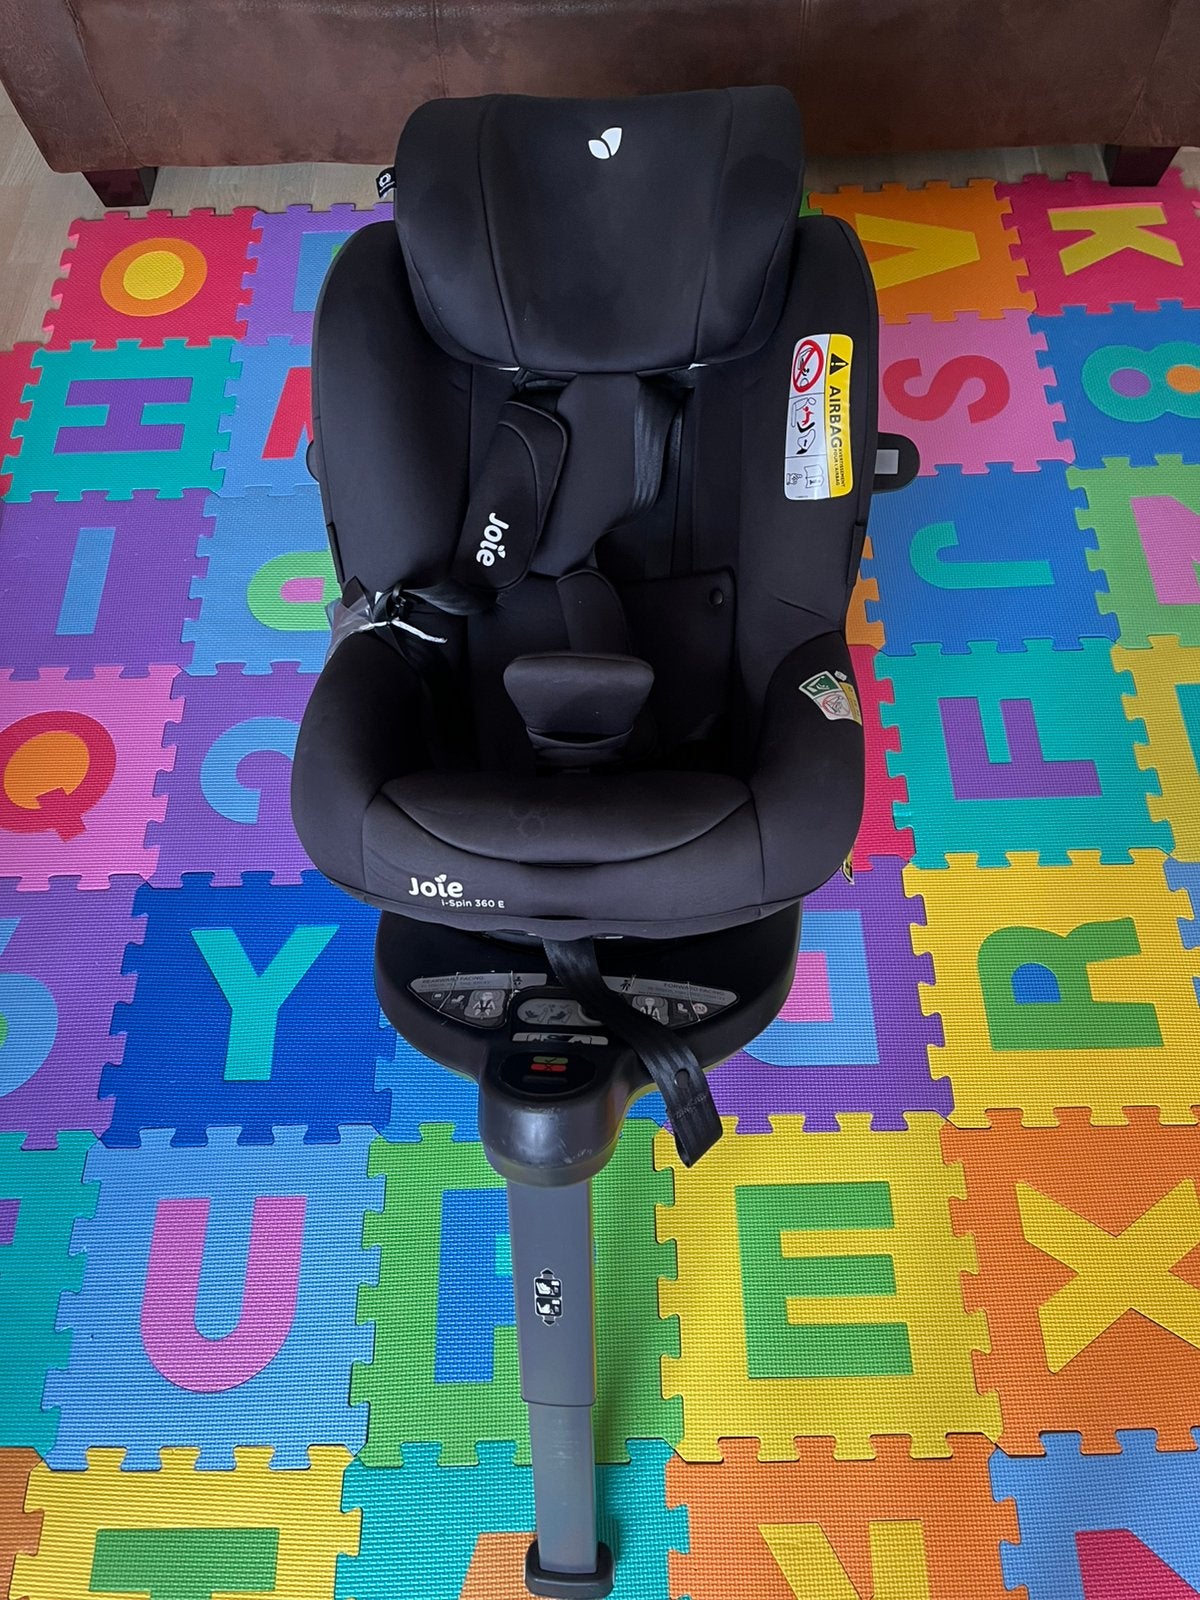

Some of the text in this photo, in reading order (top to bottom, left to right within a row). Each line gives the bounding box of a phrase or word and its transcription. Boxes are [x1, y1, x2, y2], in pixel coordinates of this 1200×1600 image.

[1047, 202, 1183, 276] K
[829, 385, 842, 447] AIRBAG
[882, 355, 1010, 424] S
[476, 512, 510, 567] Joie
[909, 521, 1055, 590] J
[0, 710, 117, 842] Q
[938, 697, 1102, 800] F
[408, 874, 464, 898] Joie
[474, 899, 495, 908] 360
[497, 900, 505, 908] E
[190, 925, 341, 1082] Y
[978, 917, 1165, 1052] R
[140, 1196, 308, 1393] U
[735, 1181, 914, 1379] E
[1015, 1178, 1200, 1374] X
